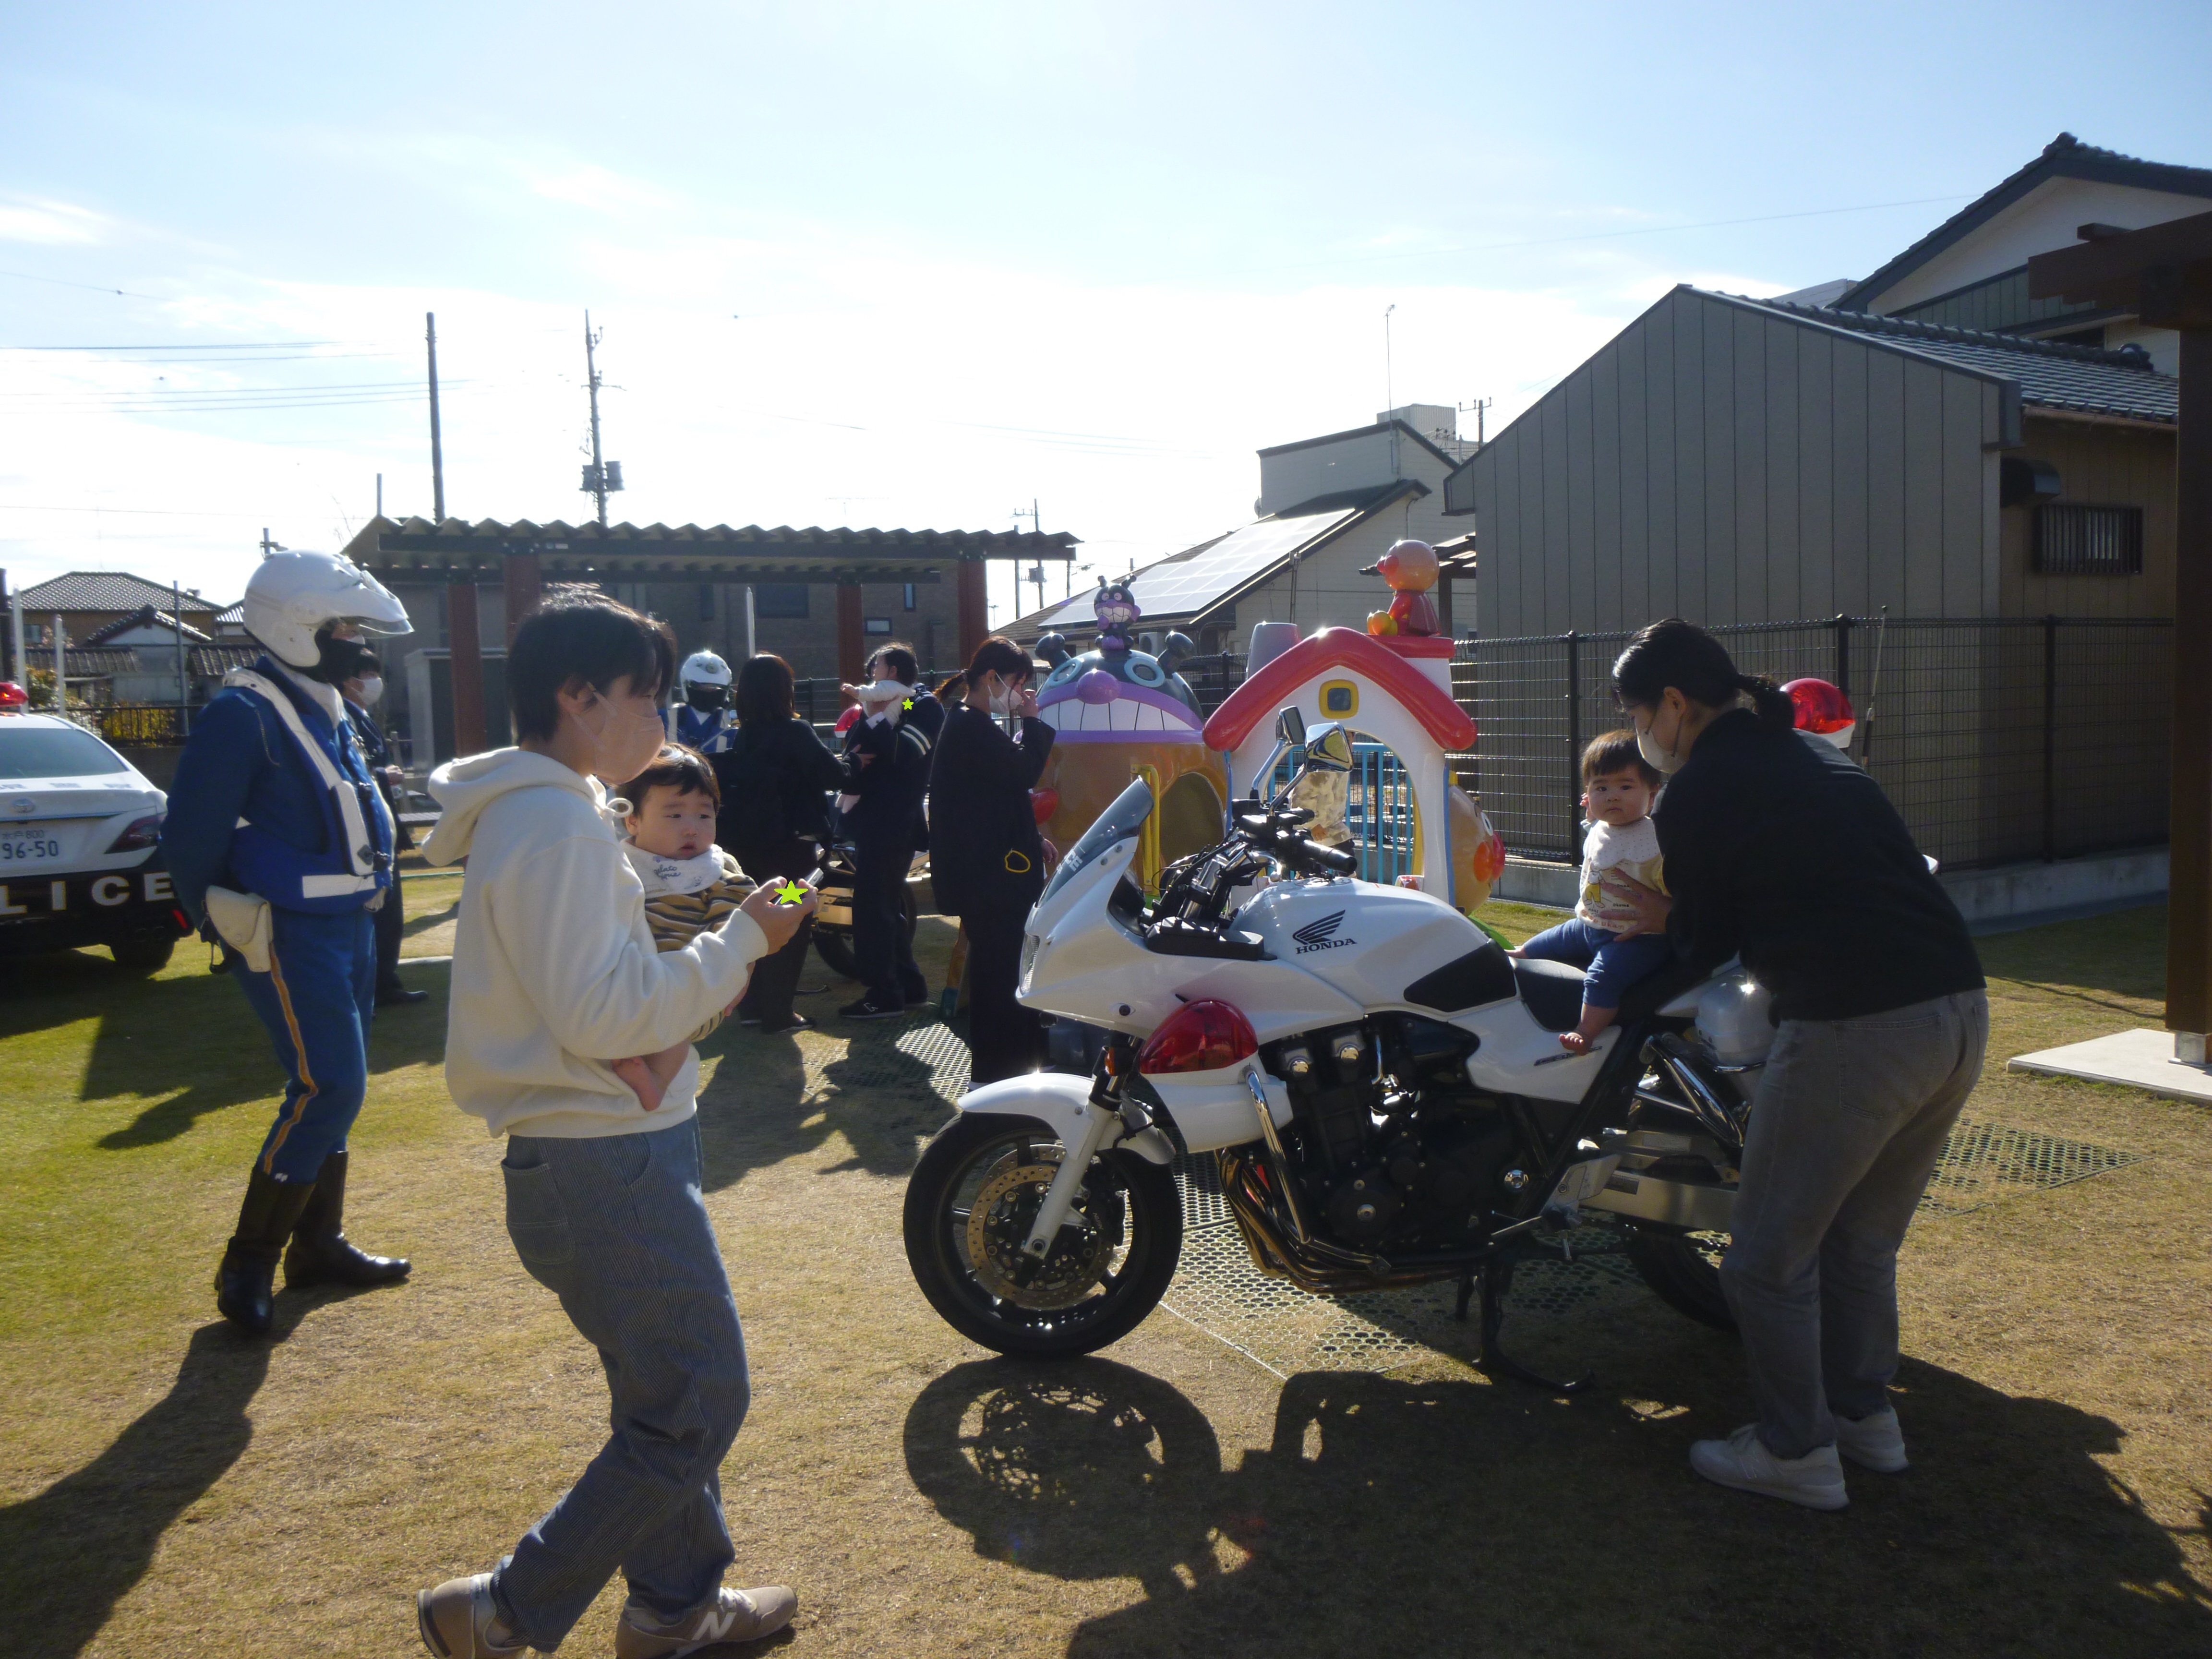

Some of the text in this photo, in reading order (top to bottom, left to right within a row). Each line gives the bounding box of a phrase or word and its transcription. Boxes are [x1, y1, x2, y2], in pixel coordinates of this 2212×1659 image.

[26, 829, 45, 839] 800
[2, 840, 59, 859] 96-50
[1296, 938, 1358, 954] HONDA
[691, 1611, 737, 1640] N
